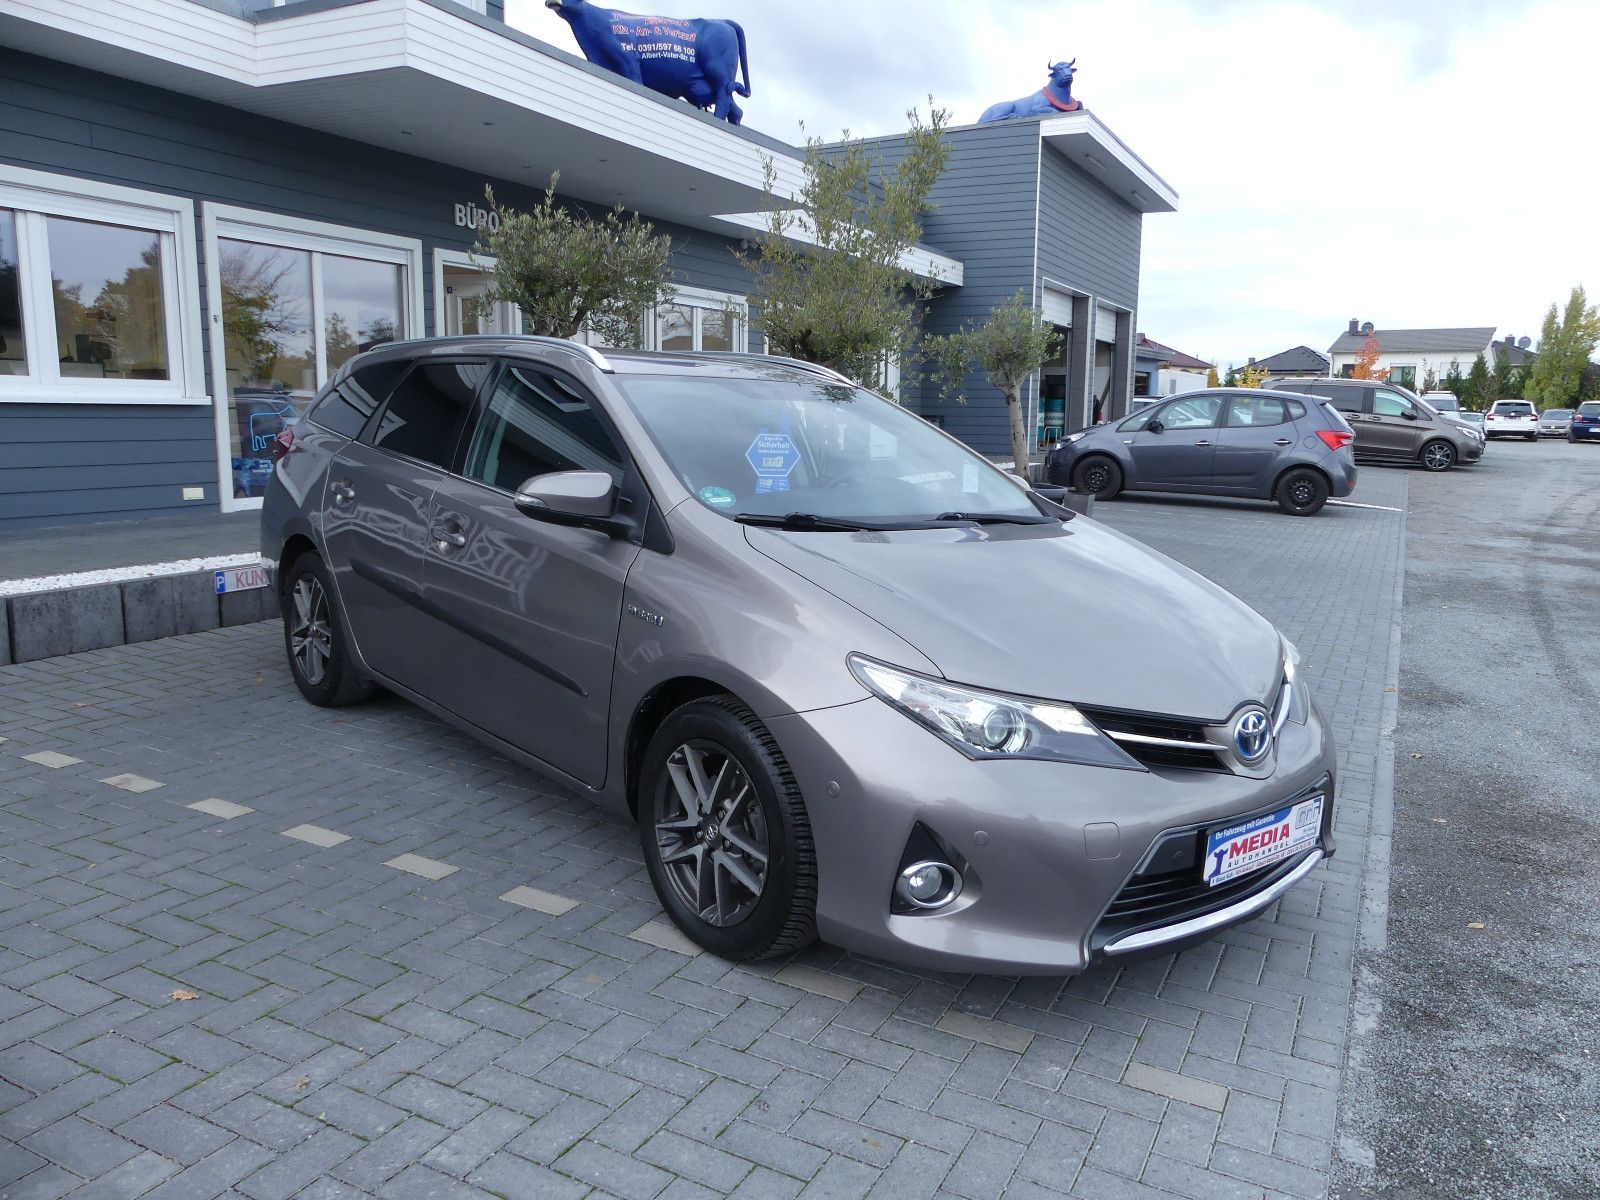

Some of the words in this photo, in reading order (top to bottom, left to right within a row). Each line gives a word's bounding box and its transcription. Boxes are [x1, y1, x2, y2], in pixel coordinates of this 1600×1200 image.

[621, 42, 636, 51] Tel.
[637, 42, 672, 52] 0391/597
[683, 46, 695, 56] 100
[454, 201, 500, 233] BÜRO
[757, 441, 791, 449] Sicherheit
[235, 570, 268, 588] KUN
[1215, 831, 1223, 840] Ihr
[1223, 823, 1246, 837] Fahrzeug
[1246, 820, 1256, 830] mit
[1254, 813, 1275, 827] Garantie
[1228, 840, 1289, 869] AUTOHANDEL
[1229, 822, 1290, 860] MEDIA
